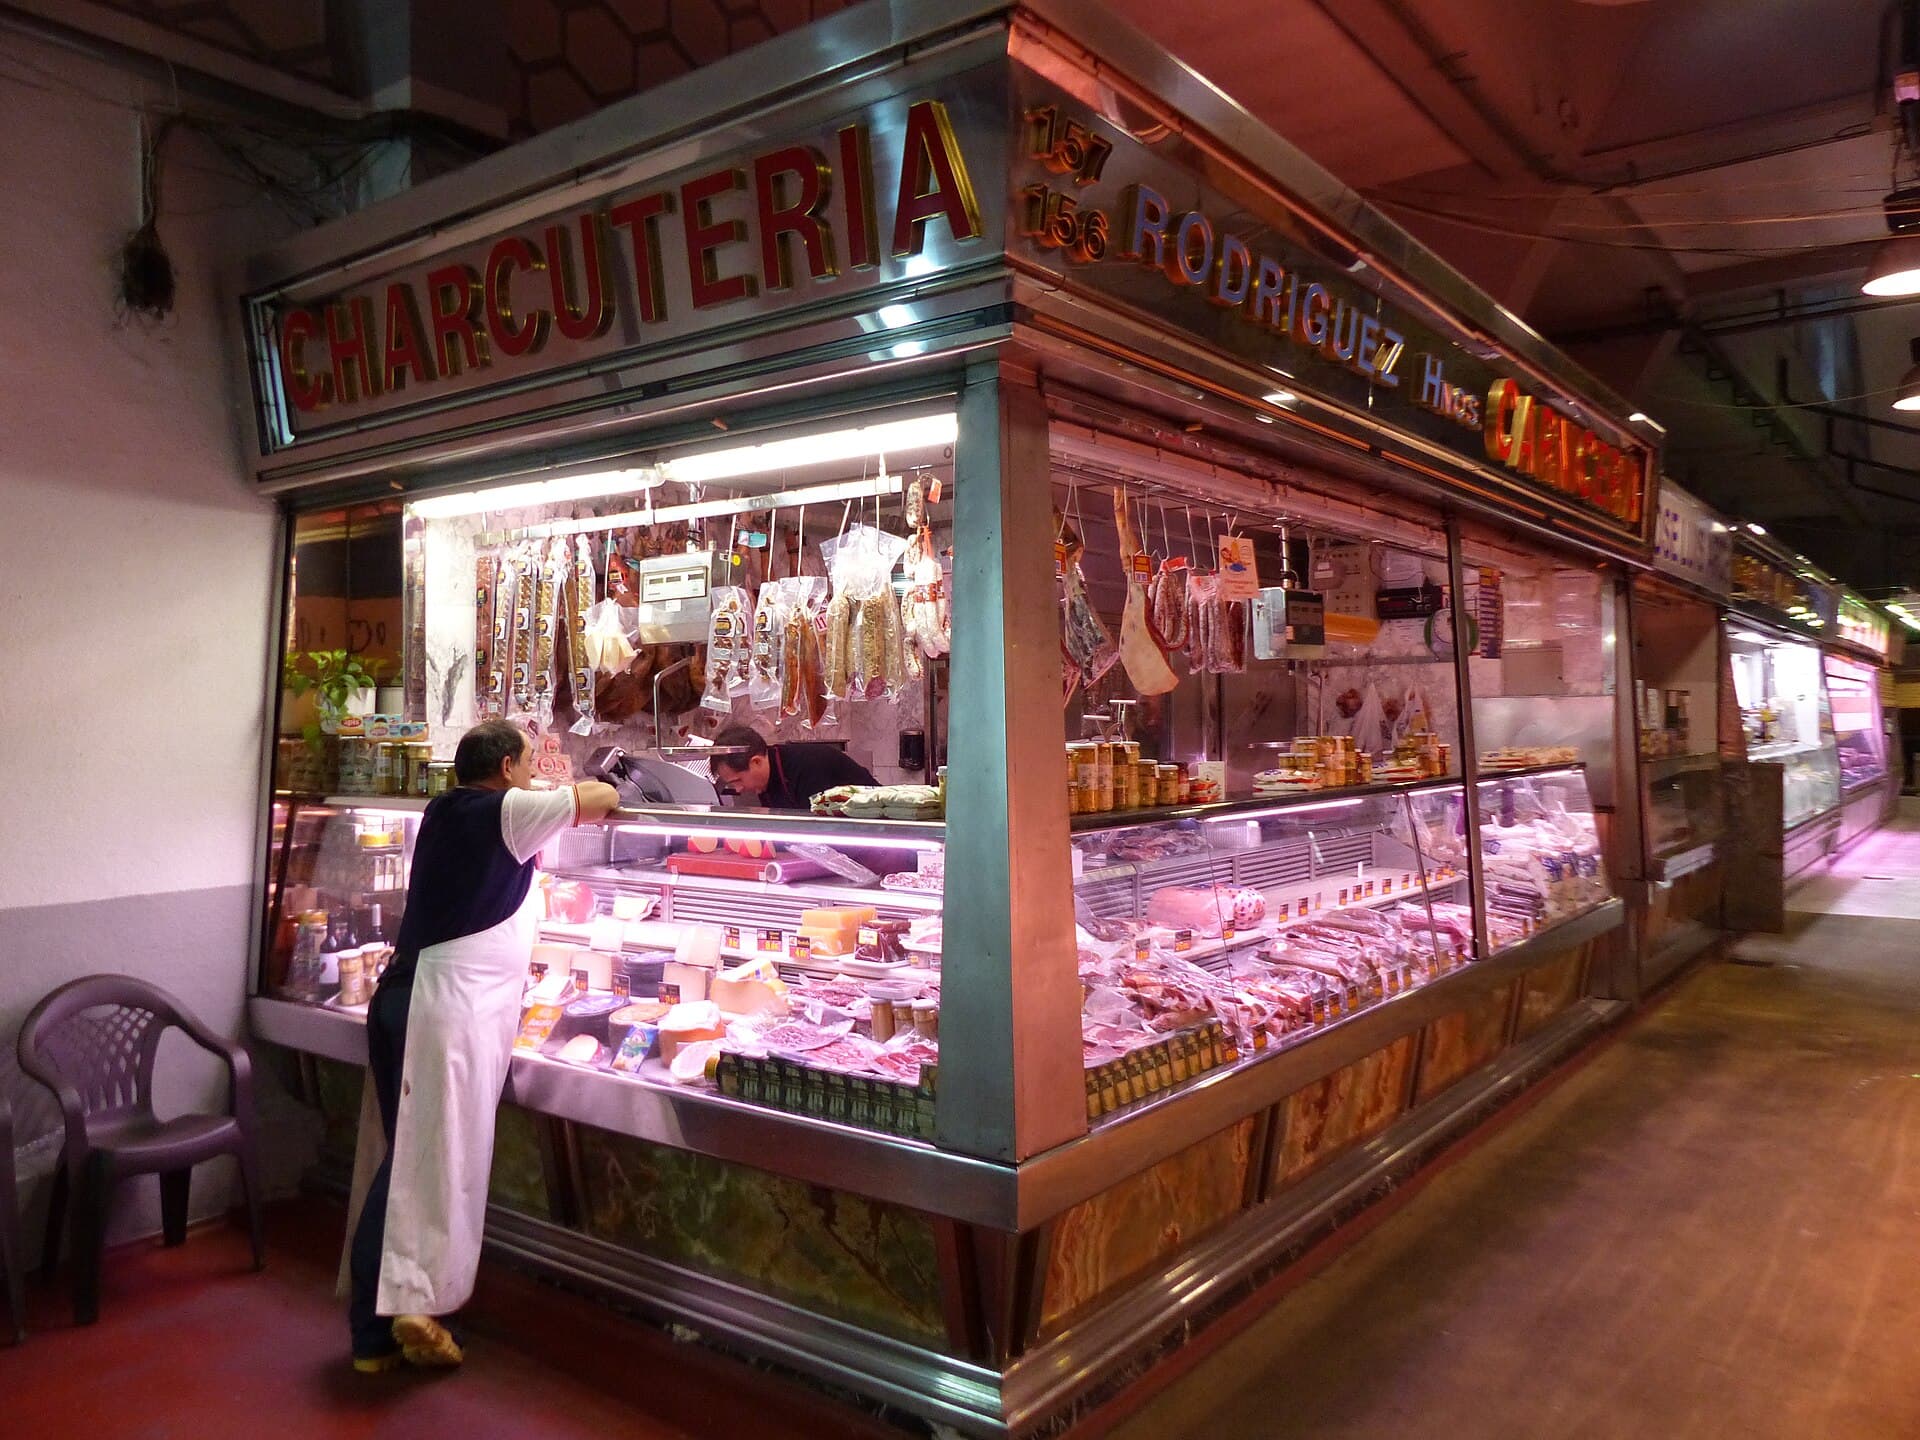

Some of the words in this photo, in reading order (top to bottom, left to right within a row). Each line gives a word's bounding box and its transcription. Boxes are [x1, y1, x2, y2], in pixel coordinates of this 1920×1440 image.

[1026, 105, 1112, 184] 157
[282, 100, 983, 411] CHARCUTERIA
[1021, 183, 1108, 262] 156
[1128, 183, 1405, 388] RODRIGUEZ
